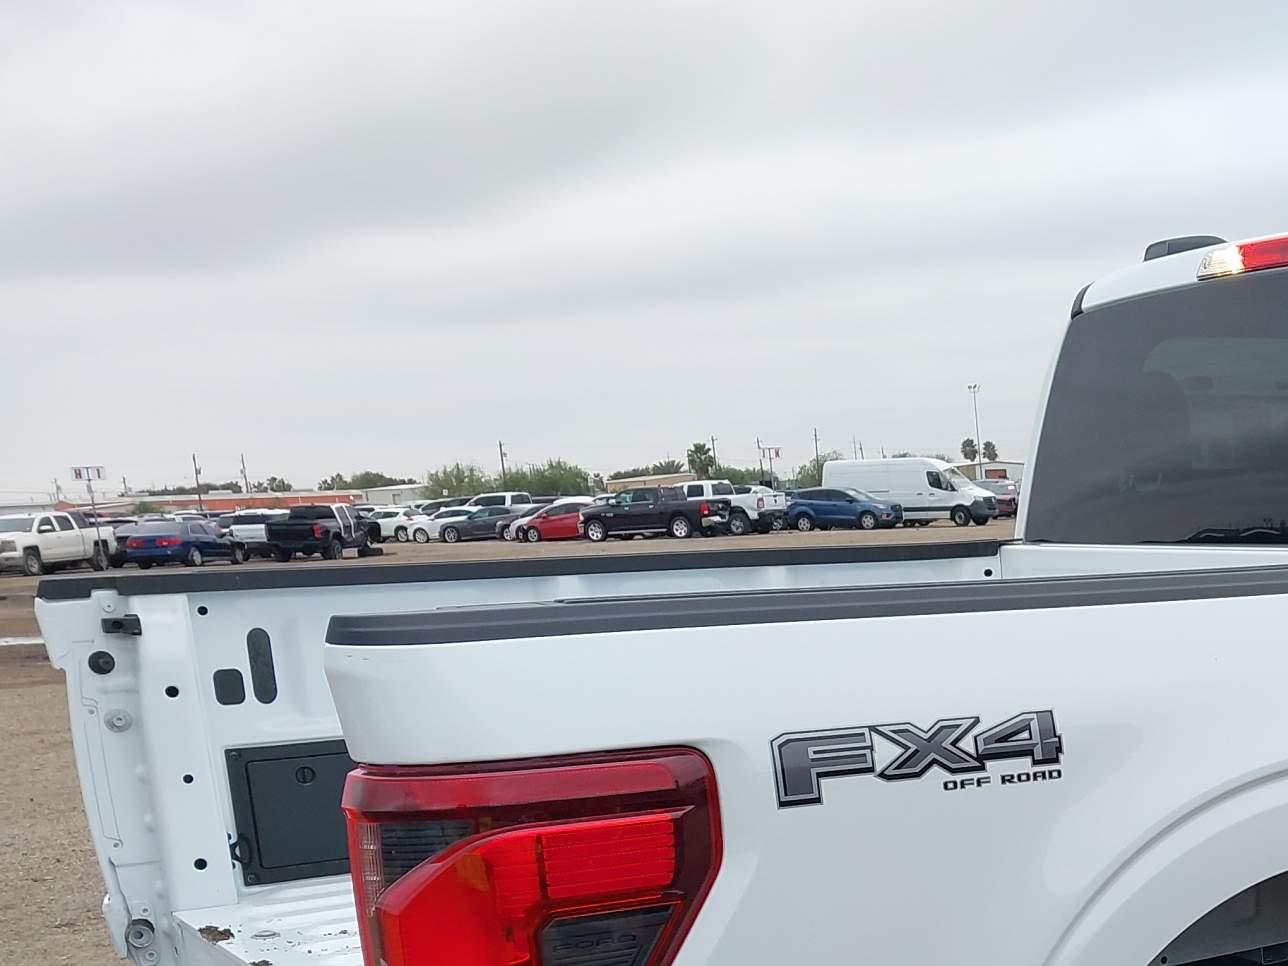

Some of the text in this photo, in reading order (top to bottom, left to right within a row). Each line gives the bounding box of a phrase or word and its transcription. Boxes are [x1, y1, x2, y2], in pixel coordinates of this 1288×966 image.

[770, 710, 1064, 809] FX4
[943, 769, 1062, 791] OFF ROAD
[553, 934, 637, 952] FORD
